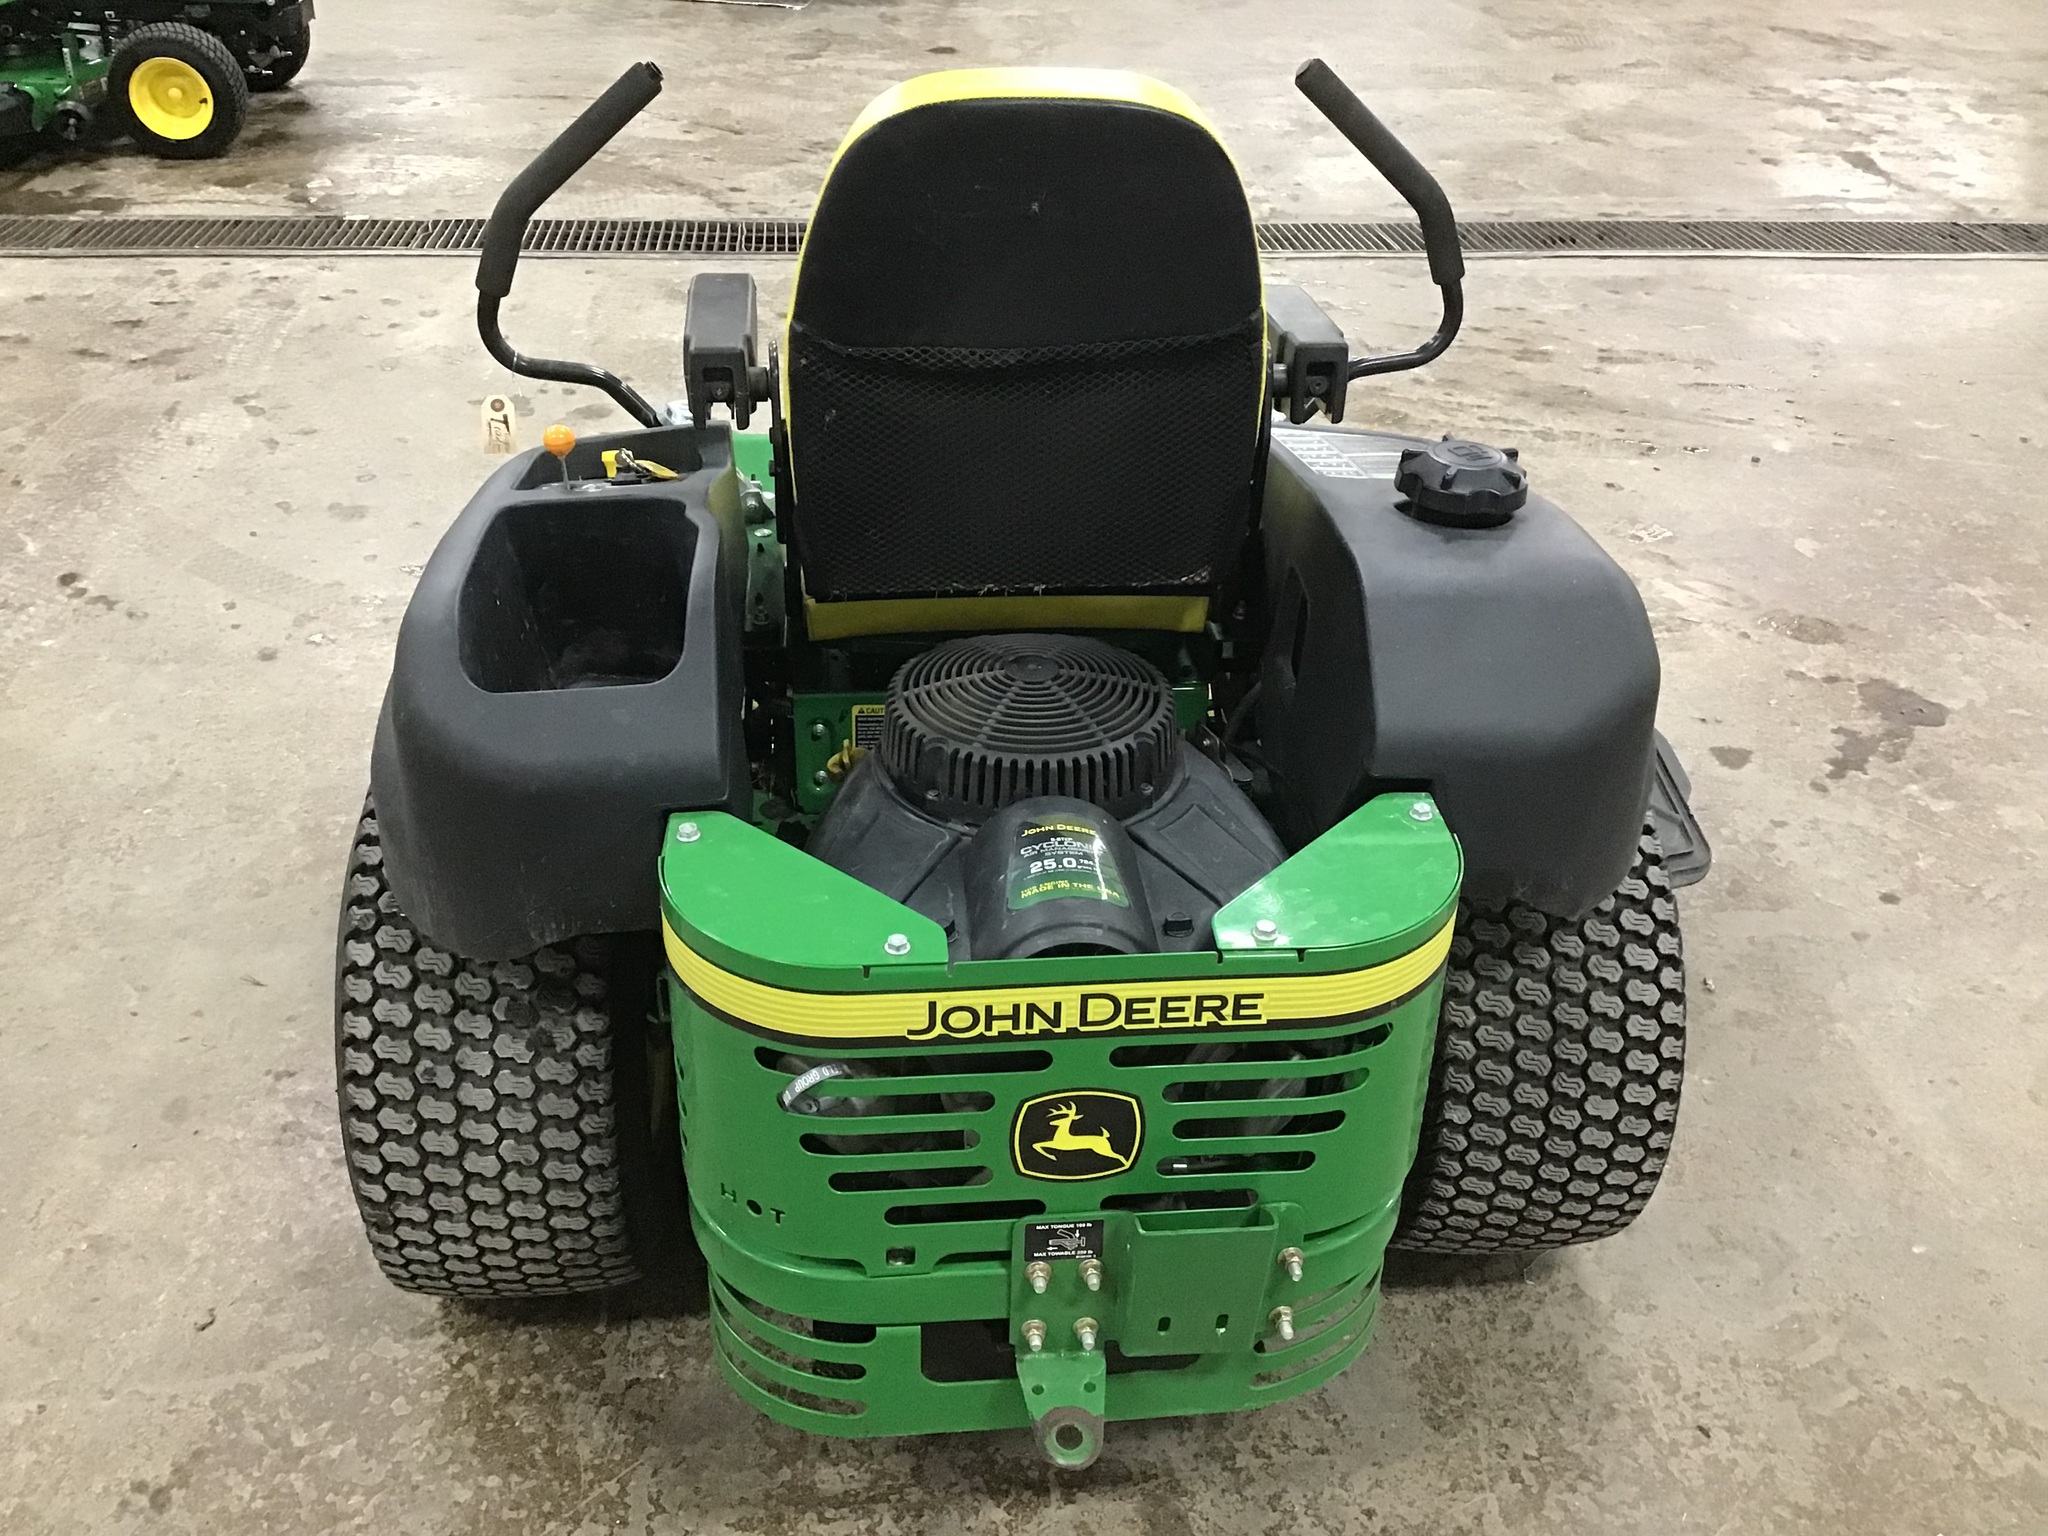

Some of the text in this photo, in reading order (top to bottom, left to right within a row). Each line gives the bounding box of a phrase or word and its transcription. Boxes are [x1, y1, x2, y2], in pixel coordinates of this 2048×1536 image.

[1021, 824, 1098, 837] JOHN DEERE
[1020, 841, 1106, 855] CYCLONI
[1029, 857, 1077, 874] 25.0
[1021, 886, 1052, 898] MADE
[906, 993, 1266, 1036] JOHN DEERE
[794, 1069, 820, 1093] GROUP
